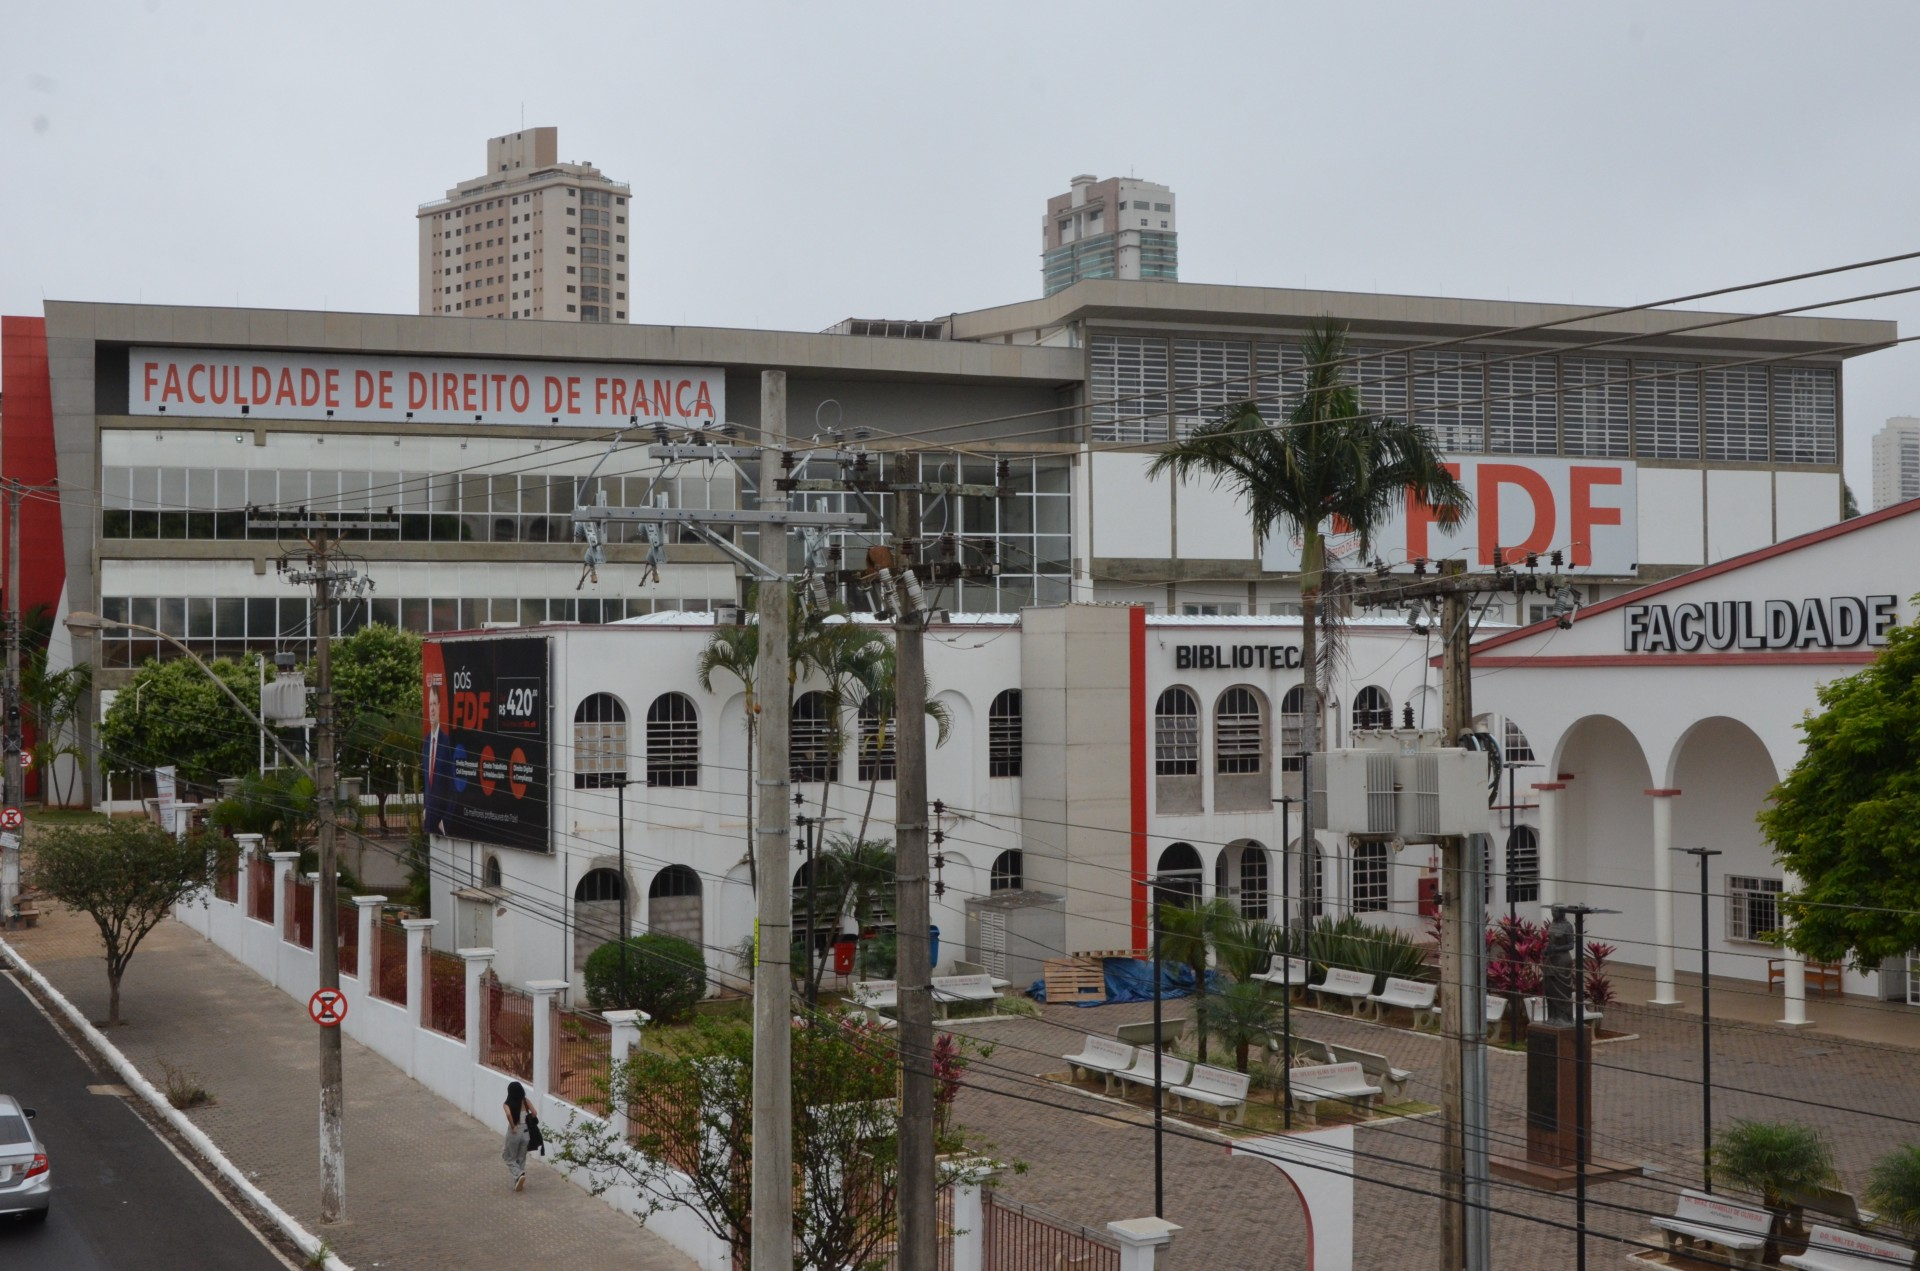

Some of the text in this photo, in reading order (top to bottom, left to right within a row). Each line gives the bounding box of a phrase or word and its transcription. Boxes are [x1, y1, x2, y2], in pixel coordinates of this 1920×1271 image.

[144, 362, 714, 418] FACULDADE DE DIREITO DE FRANCA
[1406, 462, 1622, 567] FDF
[1624, 594, 1898, 652] FACULDADE
[453, 665, 472, 694] pós
[1176, 645, 1305, 669] BIBLIOTEC
[452, 691, 491, 731] FDF
